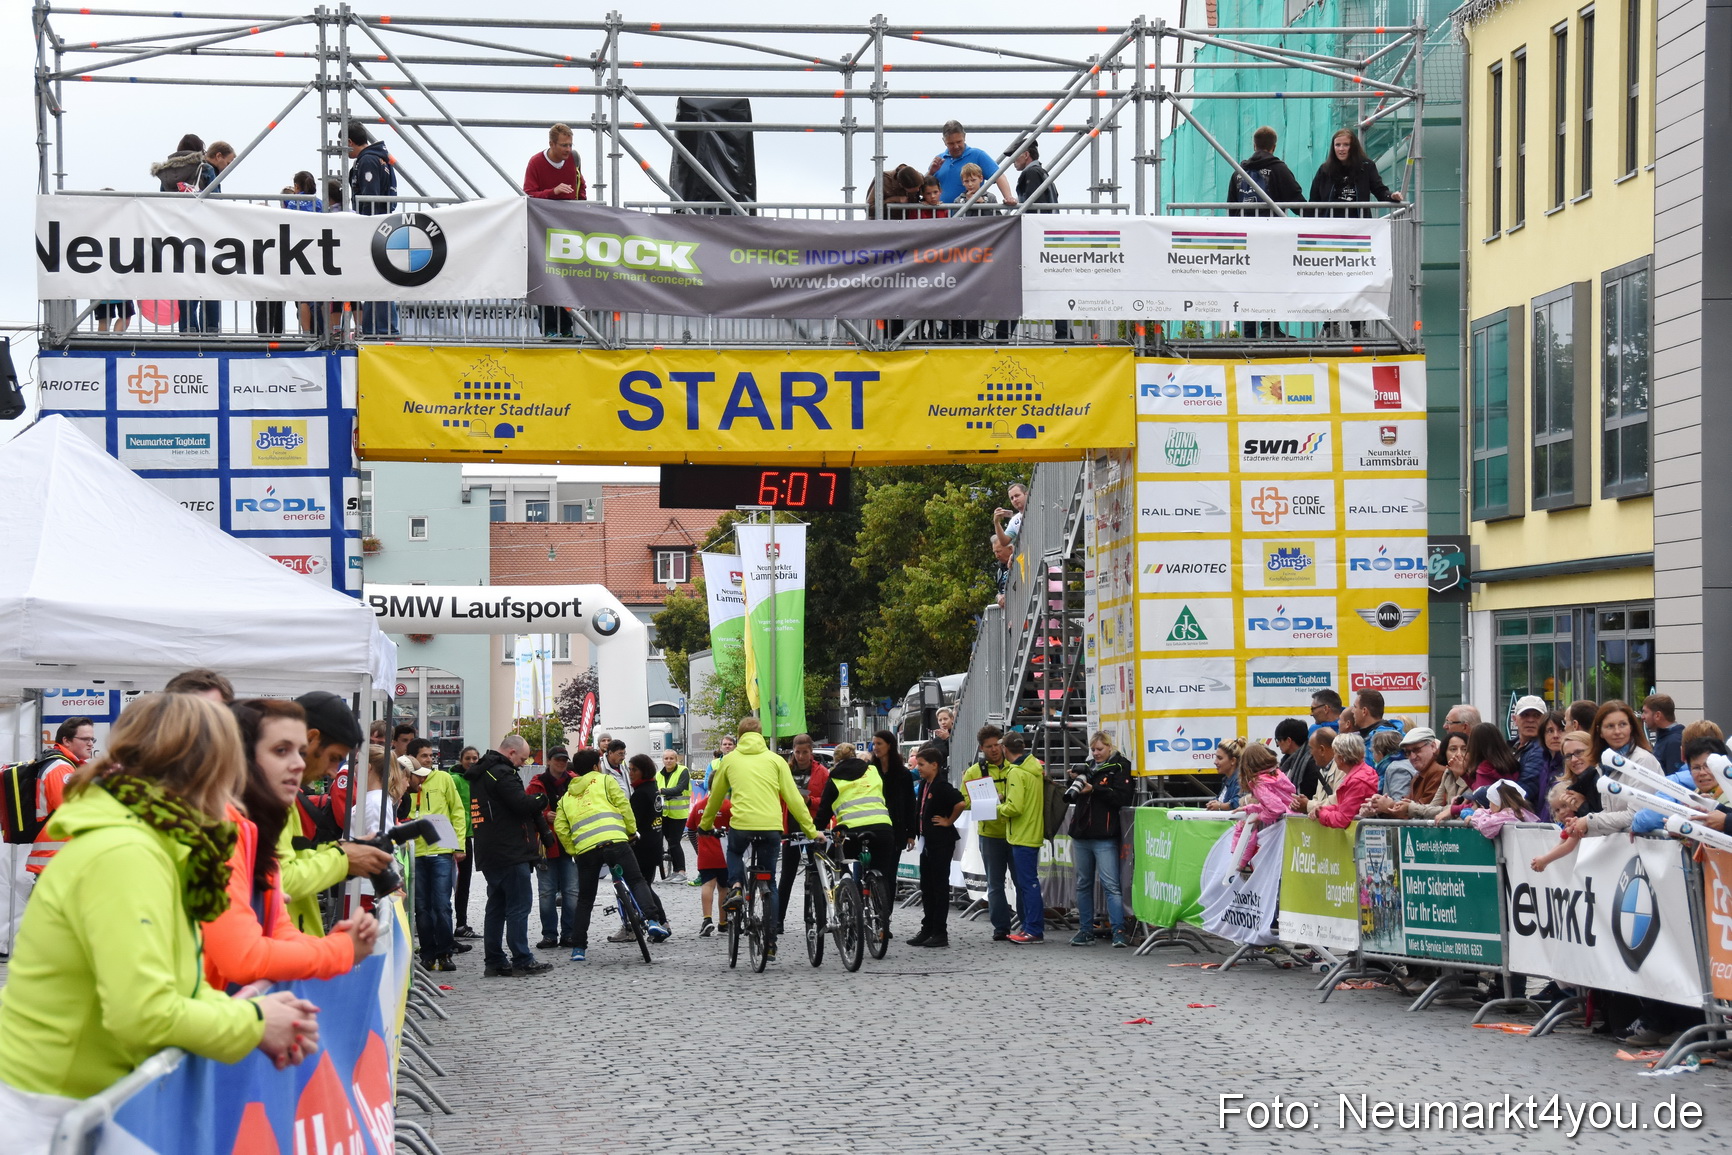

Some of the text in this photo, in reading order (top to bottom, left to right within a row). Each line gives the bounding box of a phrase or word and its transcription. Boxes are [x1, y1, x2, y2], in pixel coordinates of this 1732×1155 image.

[377, 213, 442, 238] BMW
[37, 220, 342, 277] Neumarkt
[547, 231, 698, 272] BOCK
[729, 246, 994, 266] OFFICE INDUSTRY LOUNGE
[1039, 251, 1125, 264] NeuerMarkt
[1167, 252, 1251, 266] NeuerMarkt
[1292, 254, 1377, 267] NeuerMarkt
[545, 263, 704, 289] inspired by smart concepts
[770, 272, 957, 290] www.bockonline.de
[40, 380, 100, 392] ARIOTEC
[173, 374, 203, 384] CODE
[173, 384, 209, 394] CLINIC
[1373, 389, 1399, 401] Braun
[617, 370, 881, 431] START
[1183, 398, 1223, 407] energie
[1287, 394, 1313, 402] KANN
[403, 400, 571, 418] Neumarkter Stadtlauf
[928, 402, 1092, 418] Neumarkter Stadtlauf
[129, 437, 207, 447] Neumarkter Tagblatt
[256, 431, 304, 450] Burgis
[1166, 427, 1197, 449] RUND
[1243, 439, 1299, 455] swn
[1367, 449, 1411, 457] Neumarkter
[1165, 448, 1201, 466] SCHAU
[1243, 454, 1313, 462] stadtwerke neumarkt
[1359, 456, 1419, 467] Lammsbräu
[758, 471, 837, 506] 6:07
[1292, 495, 1320, 505] CODE
[283, 512, 326, 521] energie
[1292, 505, 1326, 515] CLINIC
[1165, 563, 1227, 574] VARIOTEC
[1267, 553, 1312, 571] Burgis
[1428, 553, 1450, 581] G2
[368, 594, 583, 623] BMW Laufsport
[1378, 612, 1400, 621] MINI
[1292, 630, 1333, 639] energie
[1256, 675, 1328, 685] Neumarkter Tagblatt
[1354, 672, 1414, 687] charivari
[61, 697, 105, 706] energie
[580, 698, 594, 746] REWE
[1301, 831, 1311, 847] Der
[1040, 838, 1074, 866] BCK
[1415, 840, 1460, 855] Event-Leit-Systeme
[1290, 846, 1316, 874] Neue
[1330, 861, 1340, 875] was
[1405, 876, 1466, 898] Mehr Sicherheit
[1406, 901, 1457, 924] für Ihr Event!
[1408, 939, 1483, 957] Miet & Service Line: 09181 6352
